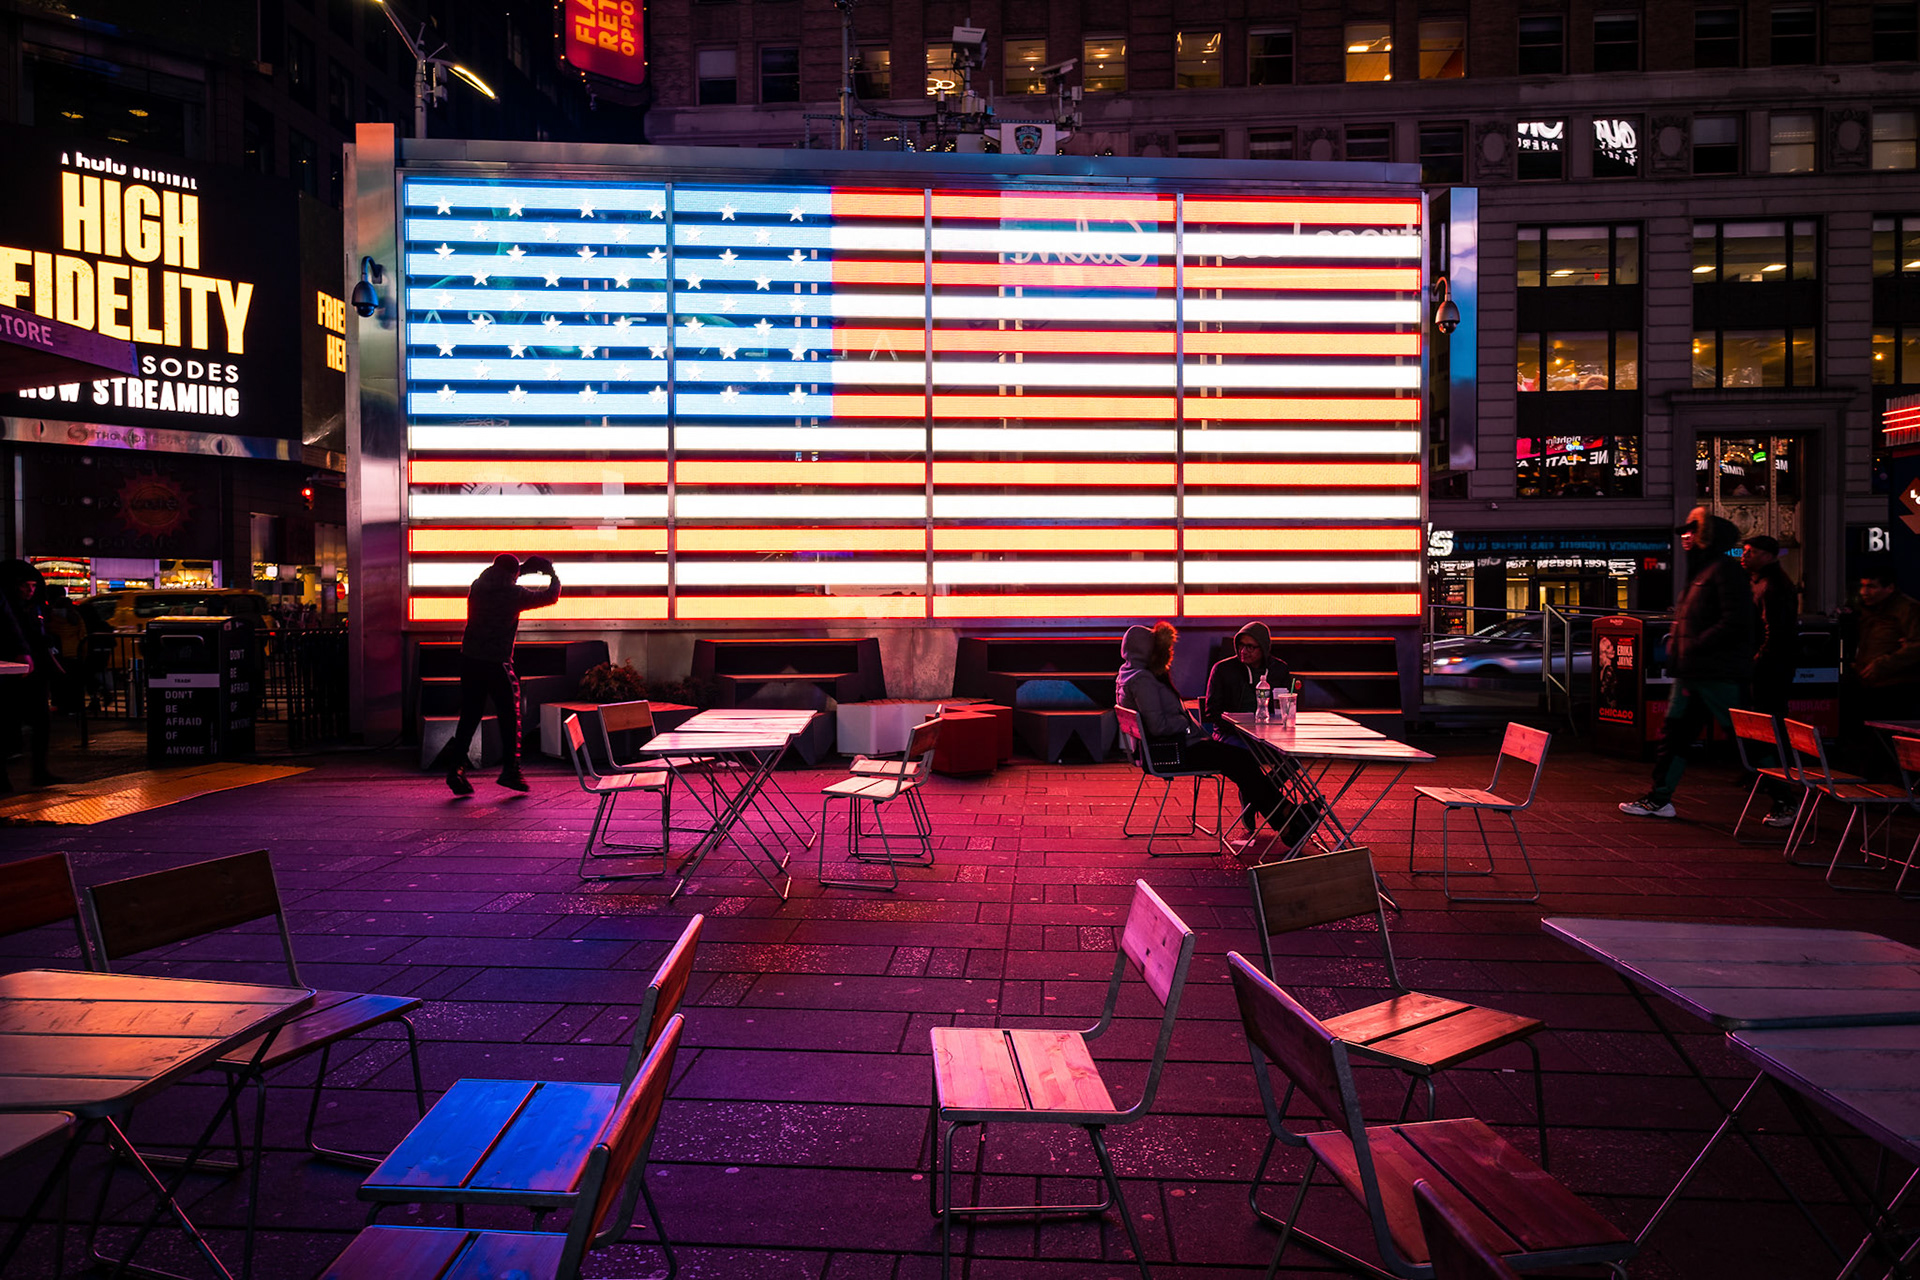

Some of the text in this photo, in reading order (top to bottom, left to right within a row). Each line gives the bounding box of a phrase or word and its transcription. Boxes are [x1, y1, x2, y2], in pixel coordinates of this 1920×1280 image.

[61, 151, 199, 190] A hulu ORIGINAL
[61, 171, 200, 270] HIGH
[0, 244, 254, 355] FIDELITY
[92, 377, 240, 418] STREAMING
[1616, 645, 1634, 656] ERIKA
[165, 690, 193, 699] DON'T
[165, 705, 178, 714] BE
[1598, 706, 1634, 721] CHICAGO
[165, 717, 202, 726] AFRAID
[165, 731, 178, 740] OF
[166, 745, 205, 755] ANYONE
